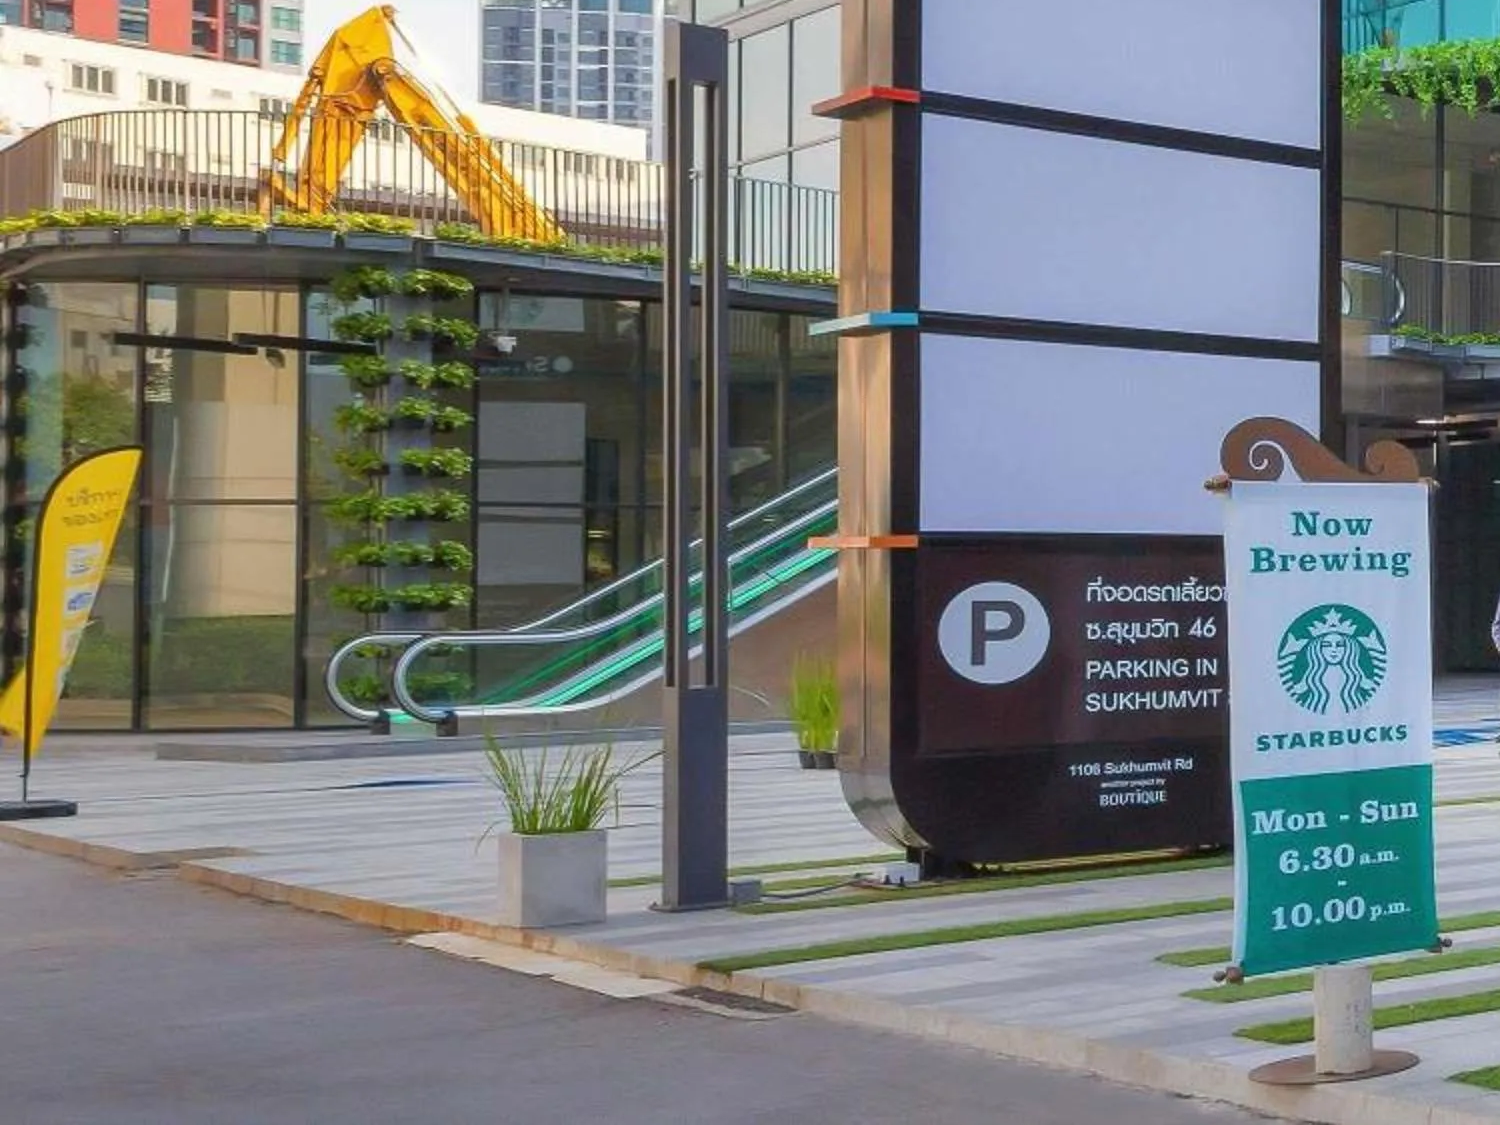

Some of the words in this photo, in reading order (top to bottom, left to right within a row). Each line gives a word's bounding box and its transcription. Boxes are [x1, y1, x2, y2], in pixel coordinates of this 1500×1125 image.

[1291, 510, 1373, 536] Now
[1249, 546, 1412, 577] Brewing
[969, 600, 1026, 667] P
[1085, 618, 1179, 645] ซ.สุขุมวิท
[1188, 616, 1217, 639] 46
[1086, 659, 1189, 679] PARKING
[1196, 658, 1218, 676] IN
[1085, 688, 1223, 712] SUKHUMVIT
[1256, 725, 1408, 752] STARBUCKS
[1103, 759, 1171, 776] Sukhumvit
[1174, 757, 1194, 771] Rd
[1251, 808, 1327, 835] Mon
[1359, 800, 1419, 824] Sun
[1279, 843, 1355, 874] 6.30
[1359, 850, 1400, 865] a.m.
[1271, 896, 1366, 931] 10.00
[1369, 901, 1411, 922] p.m.
